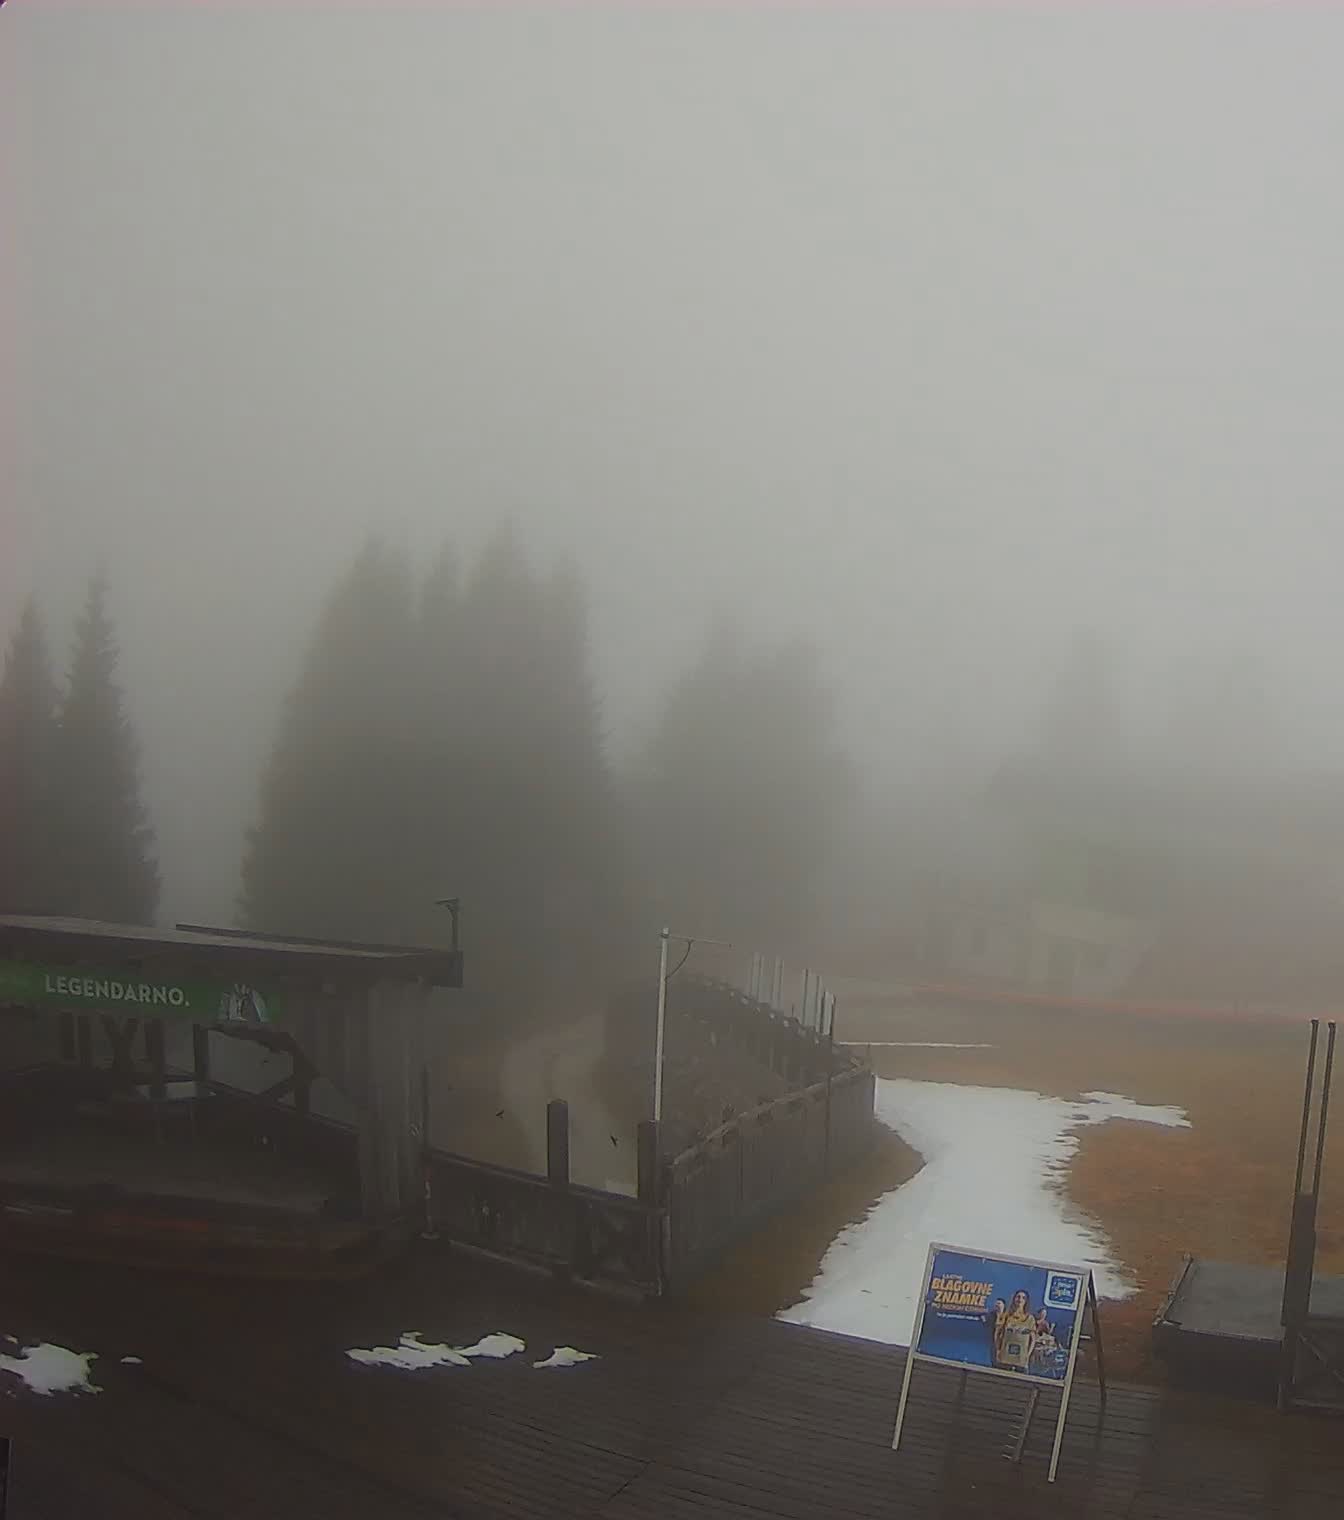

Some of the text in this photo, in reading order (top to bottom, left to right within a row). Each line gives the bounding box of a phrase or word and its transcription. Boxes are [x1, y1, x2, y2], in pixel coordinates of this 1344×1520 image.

[44, 974, 191, 1007] LEGENDARNO.
[931, 1277, 993, 1296] BLAGOVNE
[934, 1290, 987, 1308] ZNAMKE
